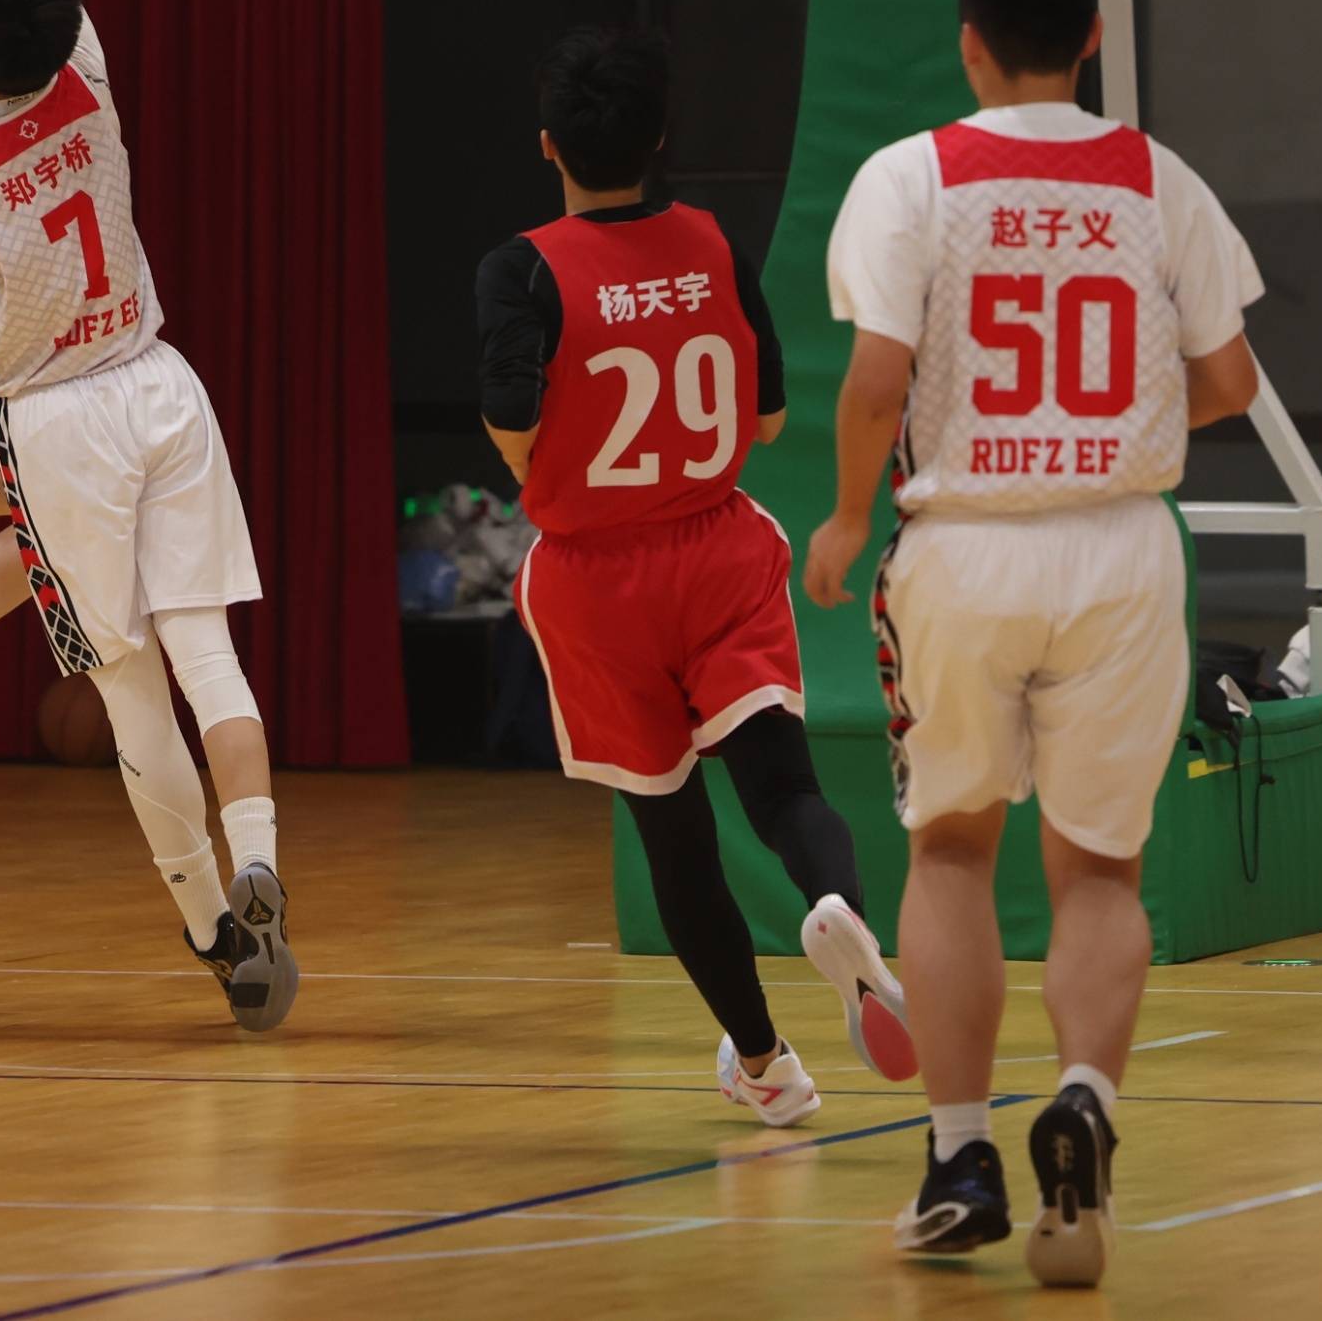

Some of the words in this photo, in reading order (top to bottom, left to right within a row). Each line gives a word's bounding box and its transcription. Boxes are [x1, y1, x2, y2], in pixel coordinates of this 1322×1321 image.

[0, 132, 93, 211] 郑宇桥
[41, 190, 111, 300] 7
[990, 206, 1117, 250] 赵子义
[596, 271, 712, 325] 杨天宇
[969, 272, 1138, 418] 50
[585, 334, 737, 488] 29
[970, 437, 1064, 475] RDFZ
[1075, 437, 1120, 475] EF
